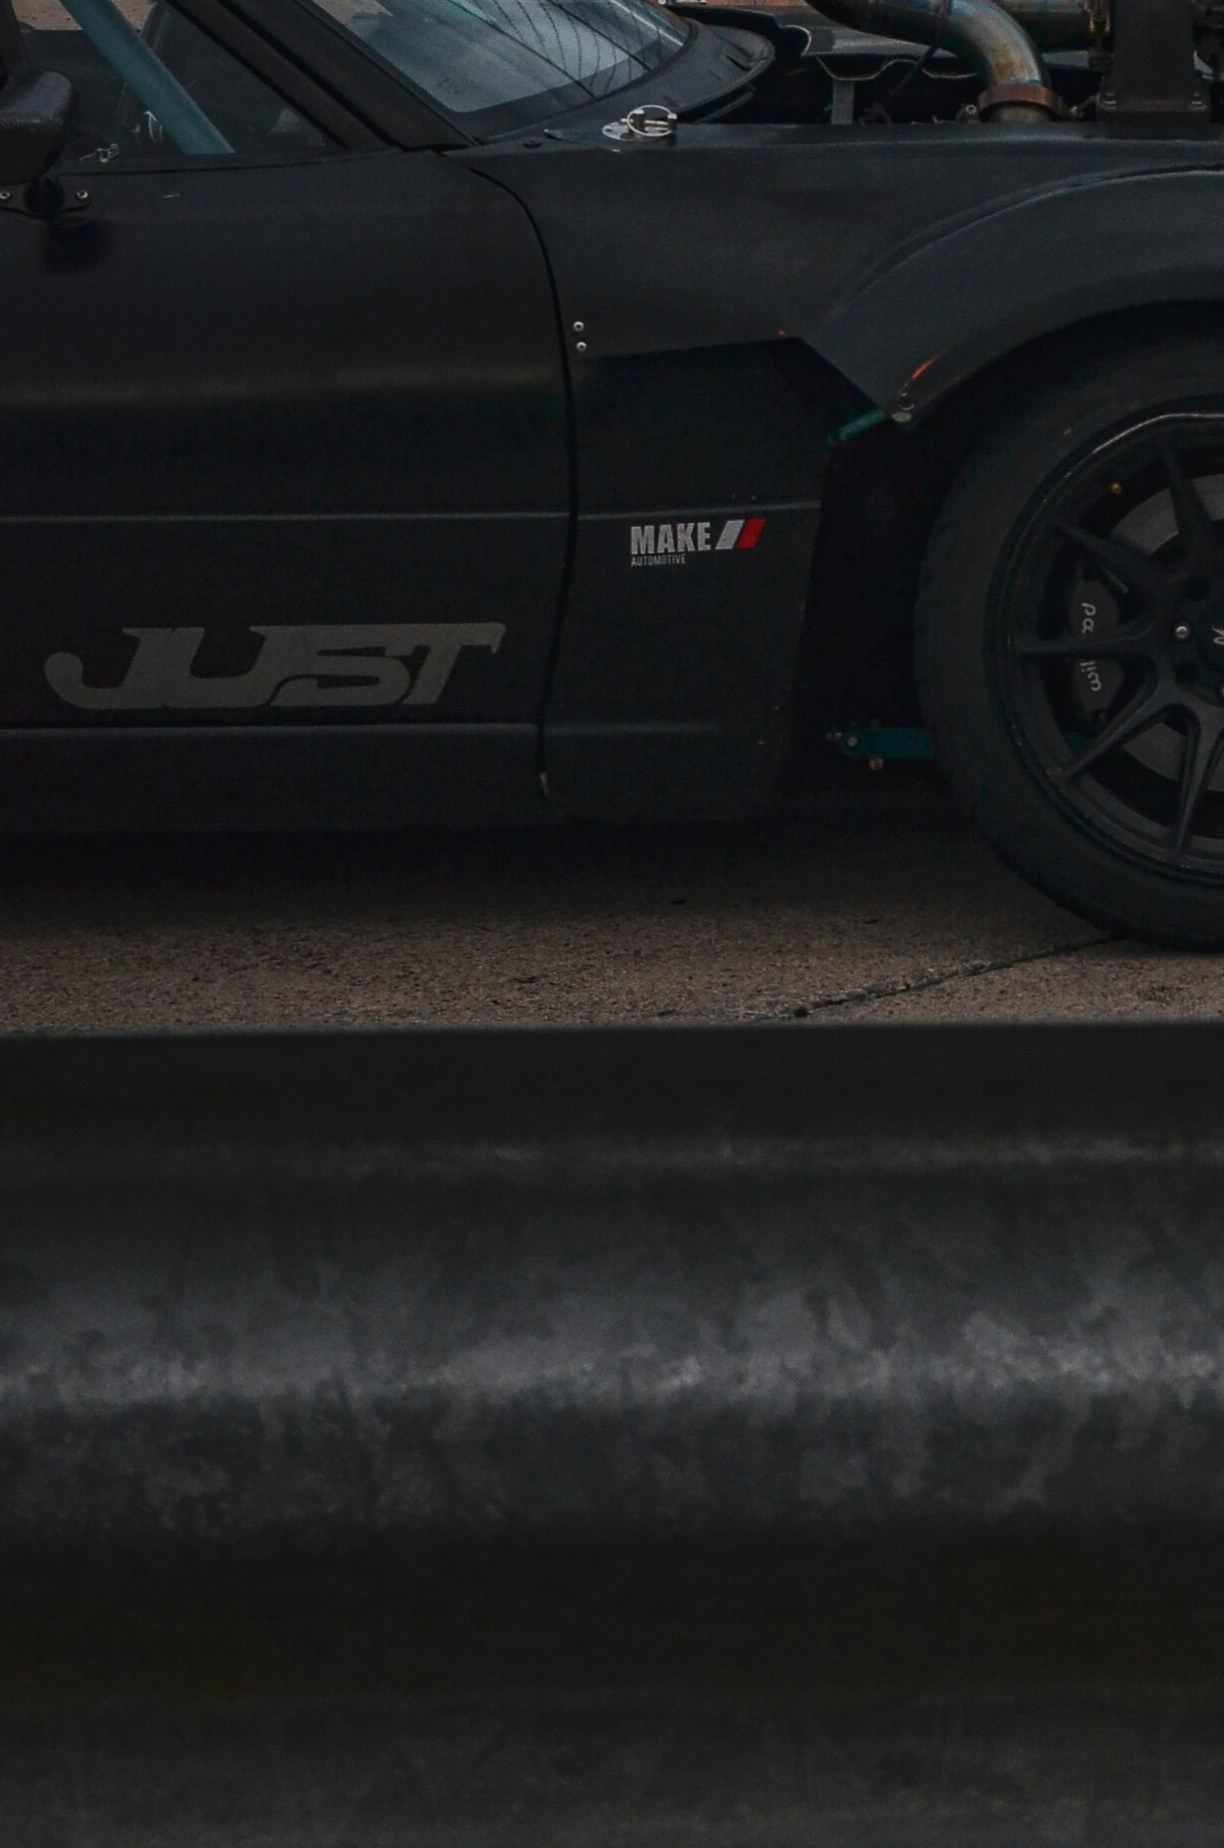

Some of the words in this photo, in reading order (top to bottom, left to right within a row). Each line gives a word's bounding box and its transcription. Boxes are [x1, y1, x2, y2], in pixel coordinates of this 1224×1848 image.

[630, 521, 712, 554] MAKE
[631, 553, 687, 567] AUTOMOTIVE
[44, 622, 506, 710] JUST
